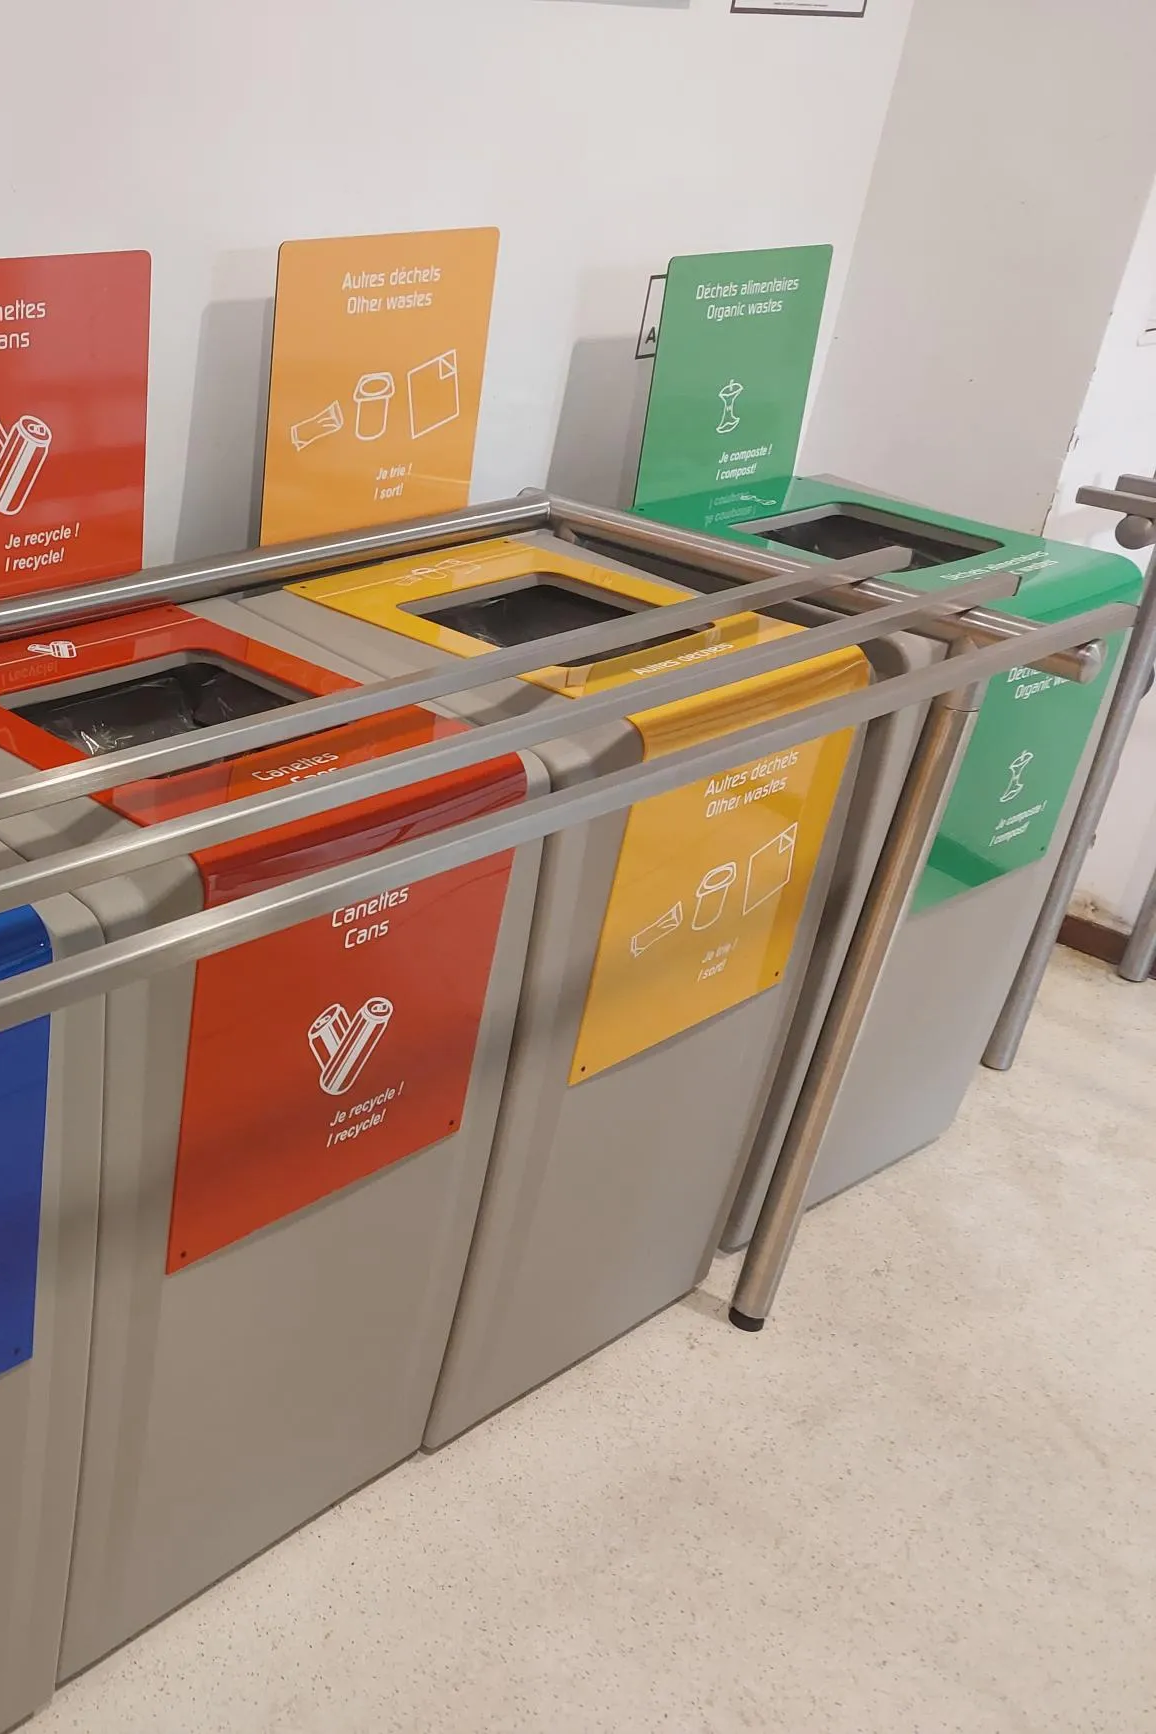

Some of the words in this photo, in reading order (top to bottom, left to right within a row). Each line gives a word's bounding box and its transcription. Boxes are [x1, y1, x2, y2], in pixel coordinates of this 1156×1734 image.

[342, 271, 385, 290] Autres
[696, 282, 738, 300] Déchets
[740, 277, 800, 296] alimentaires
[347, 295, 382, 314] Other
[386, 291, 433, 310] wastes
[707, 302, 746, 321] Organic
[748, 299, 783, 315] wastes
[4, 534, 21, 549] Je
[24, 525, 72, 546] recycle
[12, 547, 65, 571] recycle!
[251, 752, 339, 781] Canettes
[704, 771, 748, 797] Autres
[706, 795, 741, 818] Other
[743, 776, 789, 805] wastes
[332, 887, 409, 928] Canettes
[344, 919, 390, 949] Cans
[330, 1110, 347, 1127] Je
[348, 1087, 396, 1119] recycle
[333, 1108, 387, 1145] recycle!
